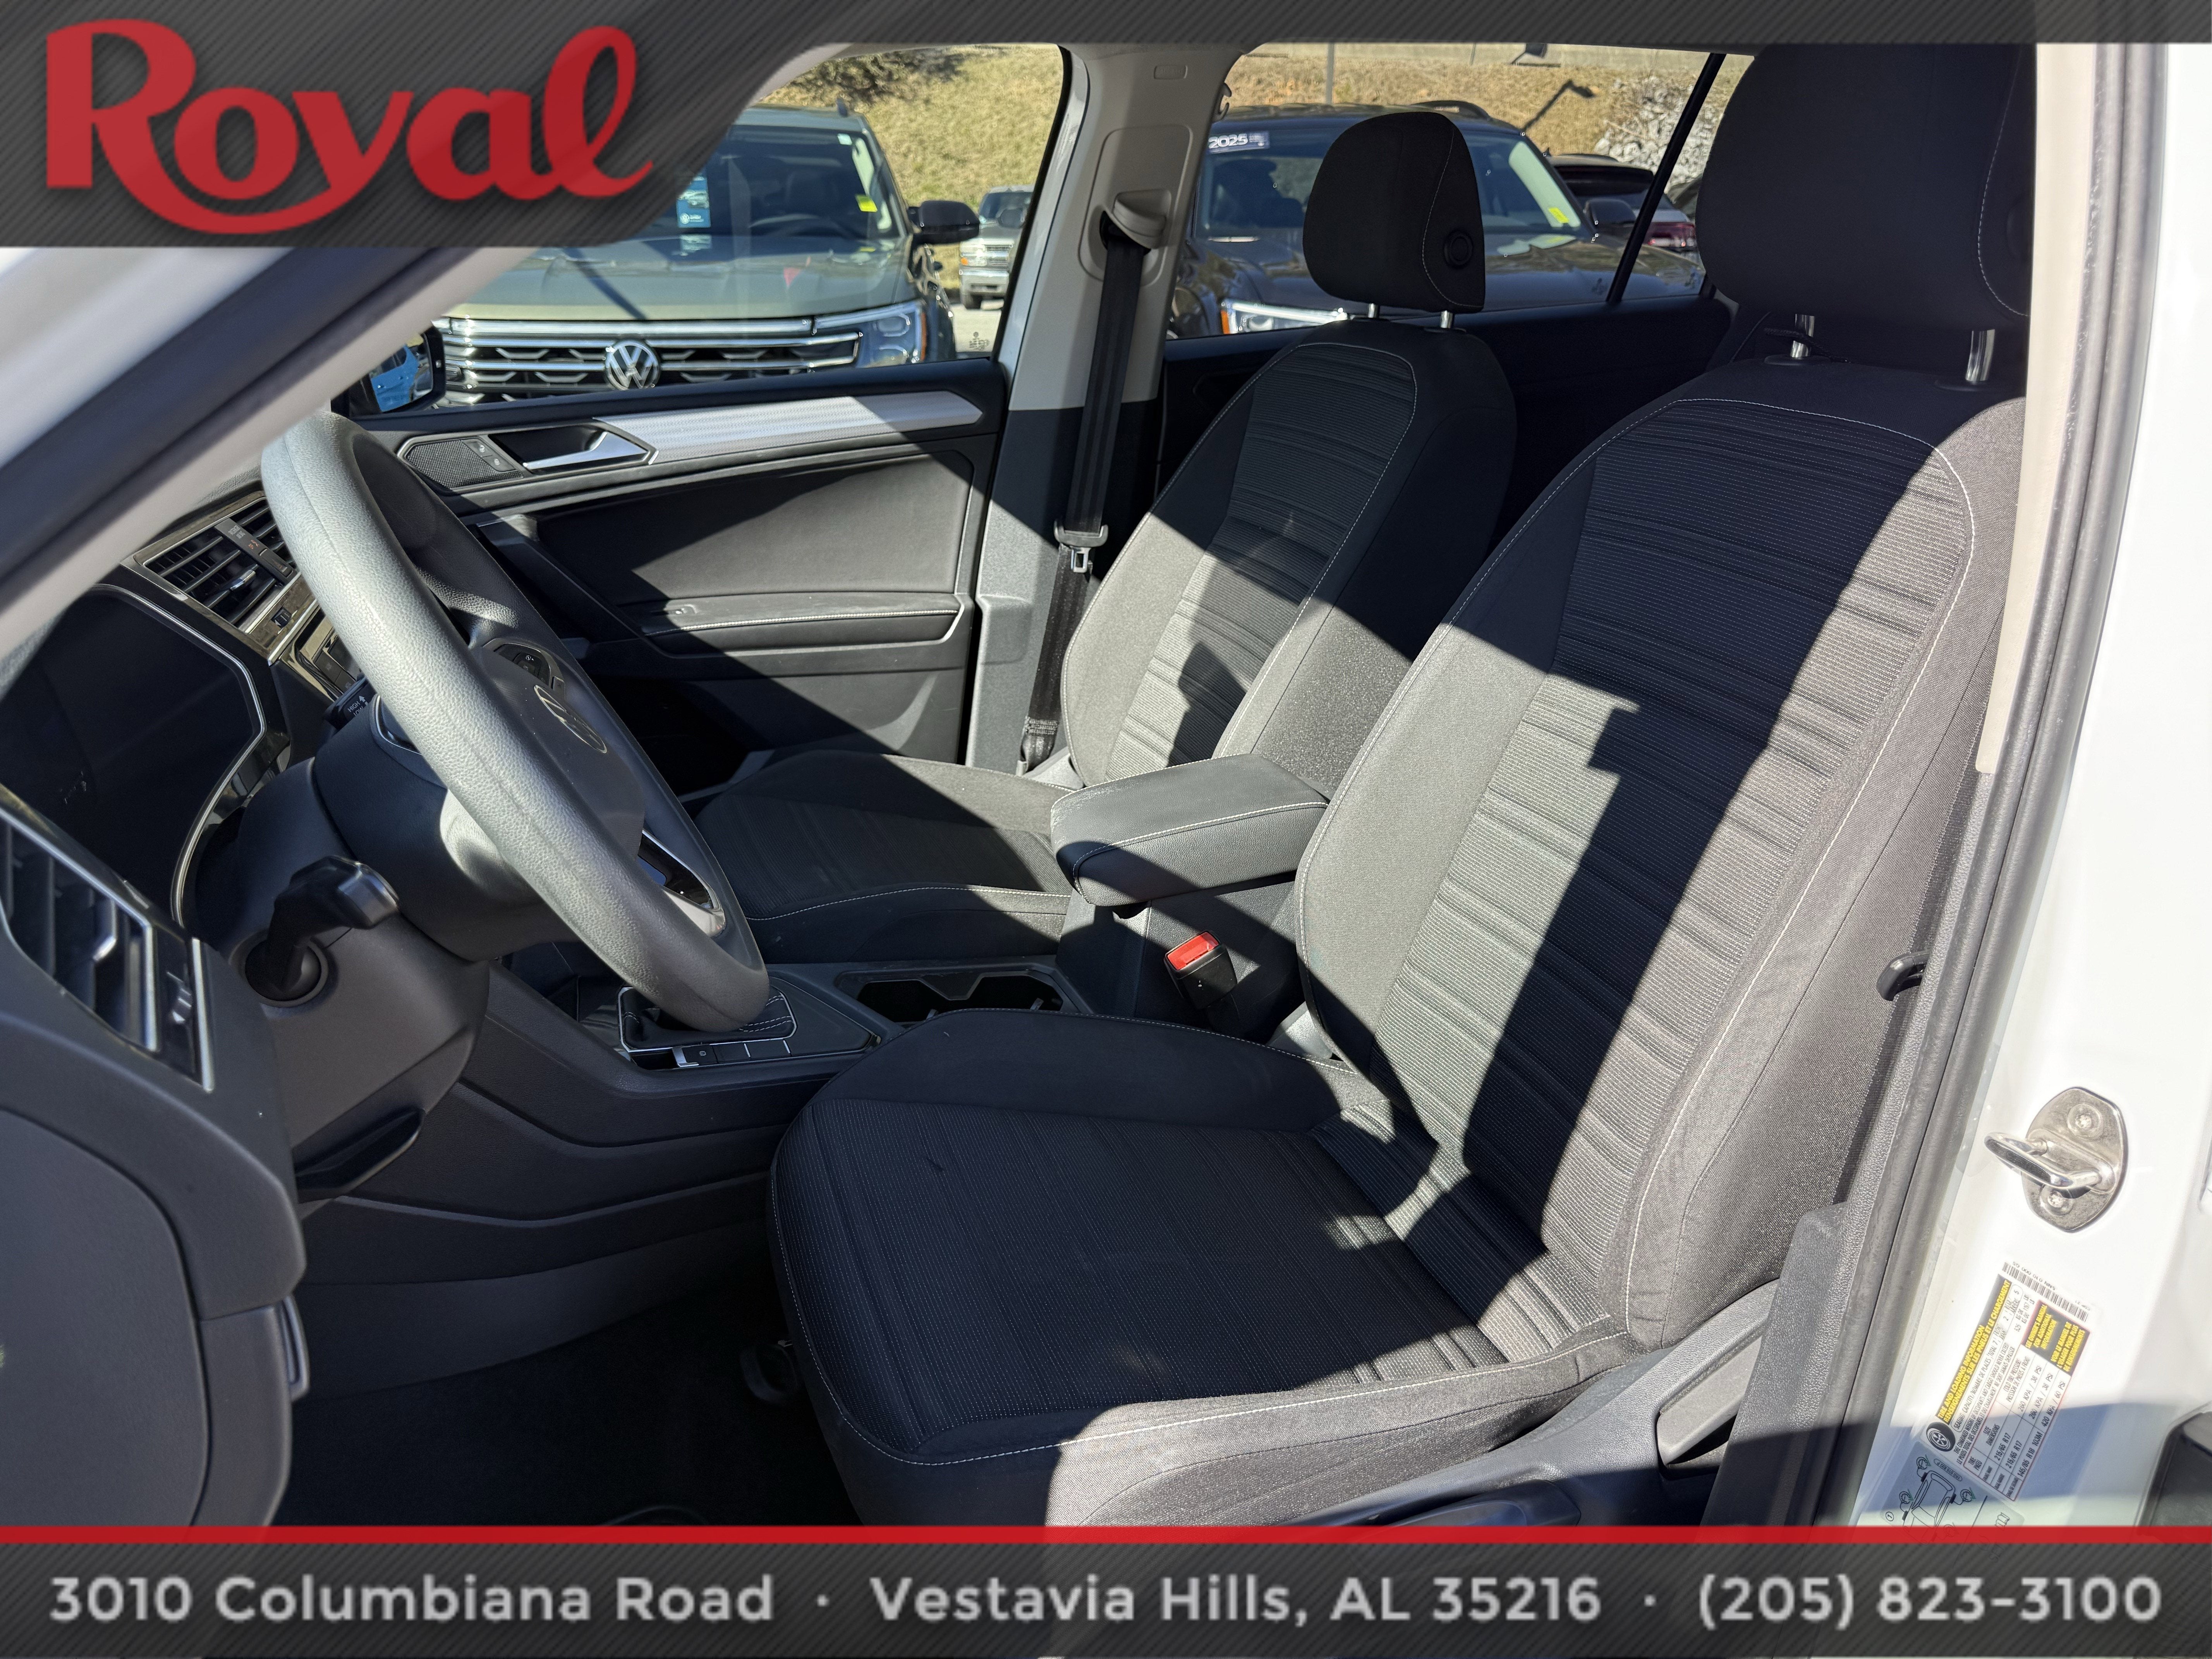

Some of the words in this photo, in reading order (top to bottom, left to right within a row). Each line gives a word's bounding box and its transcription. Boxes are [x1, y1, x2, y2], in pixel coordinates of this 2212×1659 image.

[1208, 133, 1248, 149] 2025
[347, 701, 361, 712] HIGH
[1990, 1279, 2011, 1320] CHARGEMENT
[1984, 1325, 1992, 1334] ET
[1987, 1318, 1995, 1327] LE
[2033, 1337, 2041, 1348] FOR
[2037, 1312, 2052, 1339] ADDITIONAL
[2040, 1318, 2057, 1350] INFORMATION
[2064, 1334, 2074, 1349] POUR
[2069, 1324, 2079, 1337] PLUS
[1976, 1332, 1989, 1353] PNEUS
[1972, 1351, 1980, 1363] LES
[1937, 1405, 1948, 1420] TIRE
[1943, 1391, 1954, 1407] AND
[1950, 1365, 1966, 1393] LOADING
[1962, 1324, 1985, 1367] INFORMATION
[1966, 1361, 1976, 1375] SUR
[2045, 1372, 2053, 1382] PSI
[1953, 1412, 1965, 1430] SEATING
[1980, 1357, 1991, 1372] PLACES
[1988, 1345, 1997, 1357] TOTAL
[2017, 1400, 2026, 1412] 260
[2022, 1388, 2032, 1401] KPA
[2030, 1374, 2038, 1383] 38
[2034, 1365, 2042, 1374] PSI
[2042, 1382, 2049, 1391] 38
[2057, 1380, 2066, 1390] PSI
[1943, 1373, 1970, 1423] RENSEIGNEMENTS
[2033, 1395, 2043, 1408] KPA
[2054, 1390, 2061, 1399] 60
[1957, 1429, 1968, 1448] COMBINED
[1965, 1417, 1975, 1432] WEIGHT
[1984, 1377, 1994, 1389] CARGO
[2028, 1407, 2037, 1420] 260
[2045, 1403, 2056, 1416] KPA
[2040, 1415, 2050, 1428] 420
[1958, 1448, 1967, 1461] POIDS
[1963, 1439, 1971, 1451] TOTAL
[1970, 1415, 1983, 1436] OCCUPANTS
[1983, 1425, 1991, 1436] SIZE
[1986, 1423, 2000, 1446] DIMENSIONS
[1994, 1442, 2006, 1462] 215/65
[2002, 1432, 2011, 1444] R17
[2005, 1450, 2018, 1469] 215/65
[2013, 1439, 2022, 1451] R17
[2017, 1458, 2030, 1478] 145/85
[2026, 1446, 2035, 1459] R18
[2032, 1431, 2043, 1447] 103M
[1968, 1455, 1976, 1466] TIRE
[1973, 1459, 1982, 1471] PNEU
